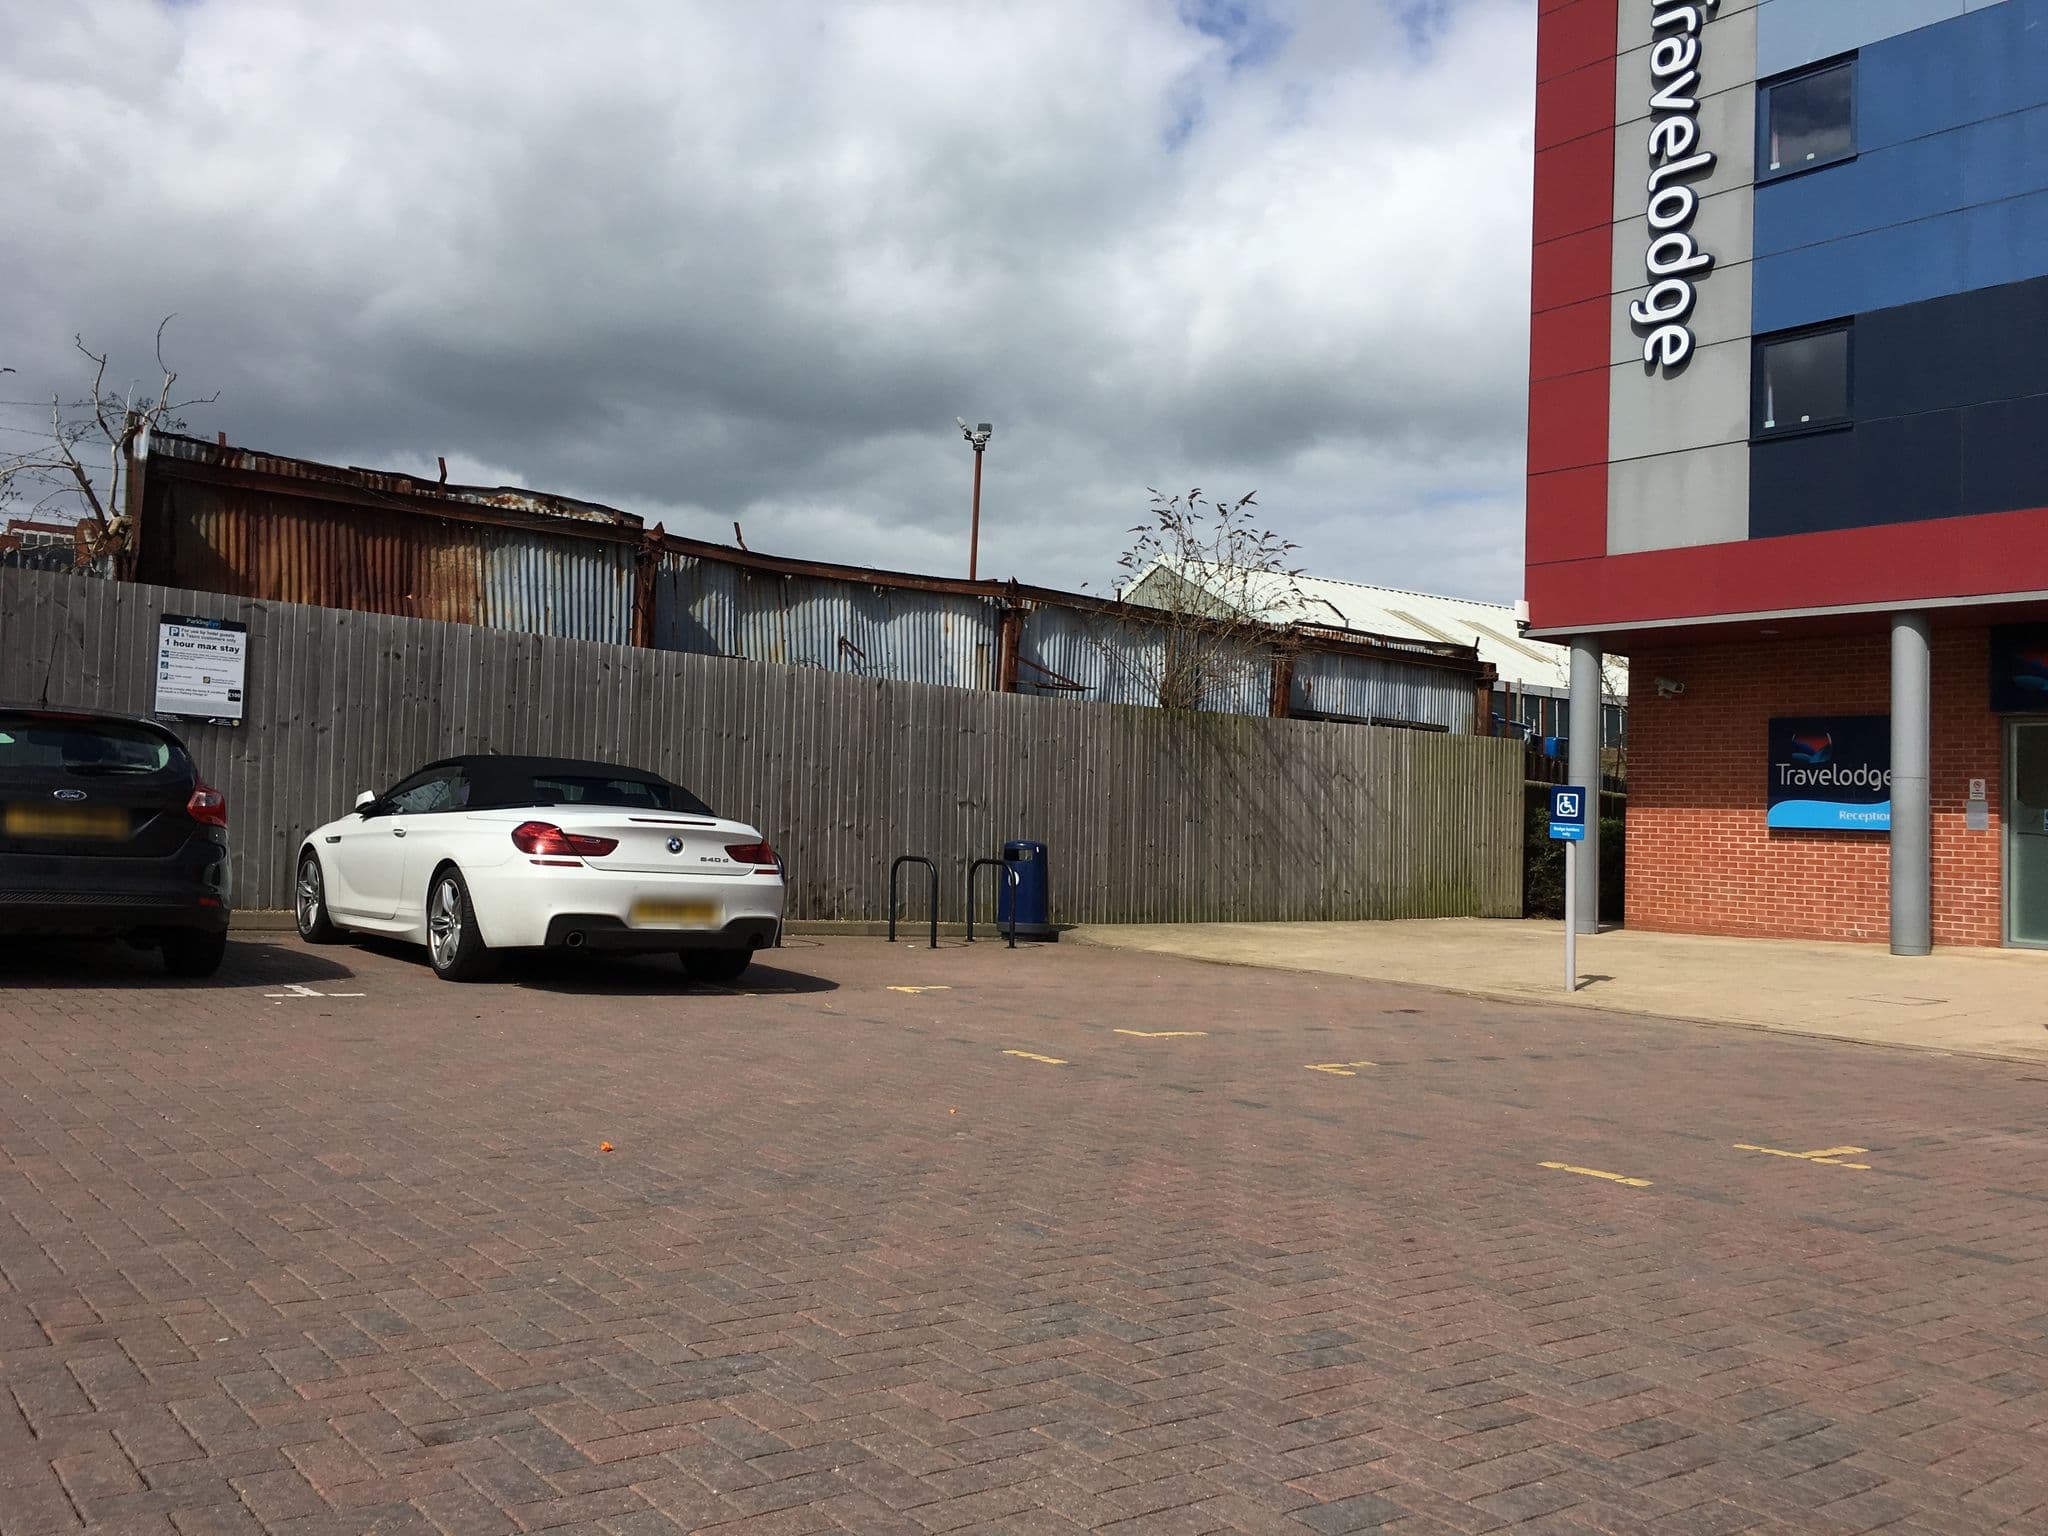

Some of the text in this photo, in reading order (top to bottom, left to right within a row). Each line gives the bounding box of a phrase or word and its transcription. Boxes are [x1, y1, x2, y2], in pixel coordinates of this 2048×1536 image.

[1630, 0, 1714, 366] ravelodge
[173, 639, 195, 648] hour
[197, 643, 217, 651] max
[220, 644, 240, 654] stay
[1776, 763, 1891, 792] Travelodge
